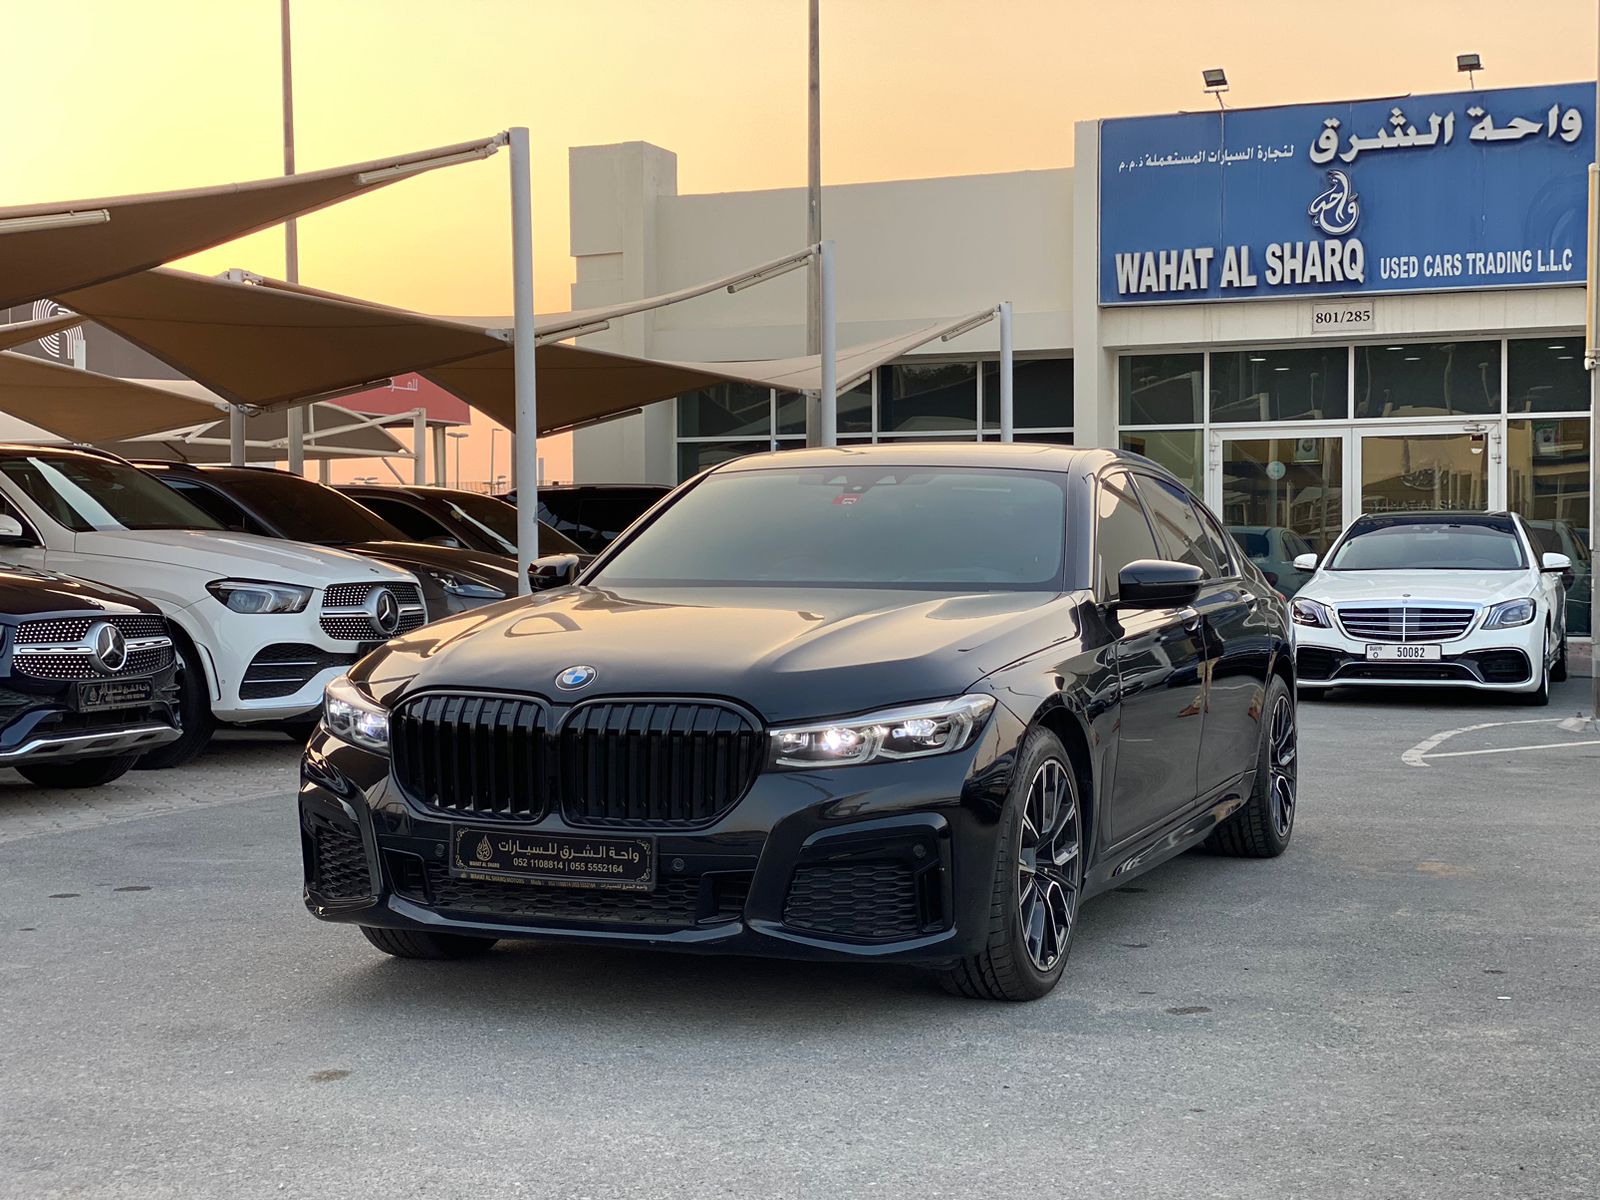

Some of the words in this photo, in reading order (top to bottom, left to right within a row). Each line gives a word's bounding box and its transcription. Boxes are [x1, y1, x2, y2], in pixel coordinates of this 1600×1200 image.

[1466, 103, 1583, 143] واحة
[1309, 106, 1455, 164] الشرق
[1145, 150, 1206, 168] المستعملة
[1207, 147, 1254, 166] السيارات
[1257, 144, 1295, 163] لتجارة
[1115, 247, 1214, 295] WAHAT
[1219, 245, 1258, 288] AL
[1264, 238, 1365, 286] SHARQ
[1380, 256, 1419, 280] USED
[1423, 253, 1462, 277] CARS
[1466, 249, 1533, 275] TRADING
[1537, 248, 1573, 272] L.L.C
[1315, 310, 1371, 324] 801/285
[1397, 647, 1425, 658] 50082
[498, 840, 557, 855] للسيارات
[560, 844, 606, 859] الشرق
[609, 846, 639, 863] واحة
[513, 858, 528, 866] 052
[529, 859, 563, 869] 1108814
[570, 862, 586, 871] 055
[587, 863, 623, 873] 5552164
